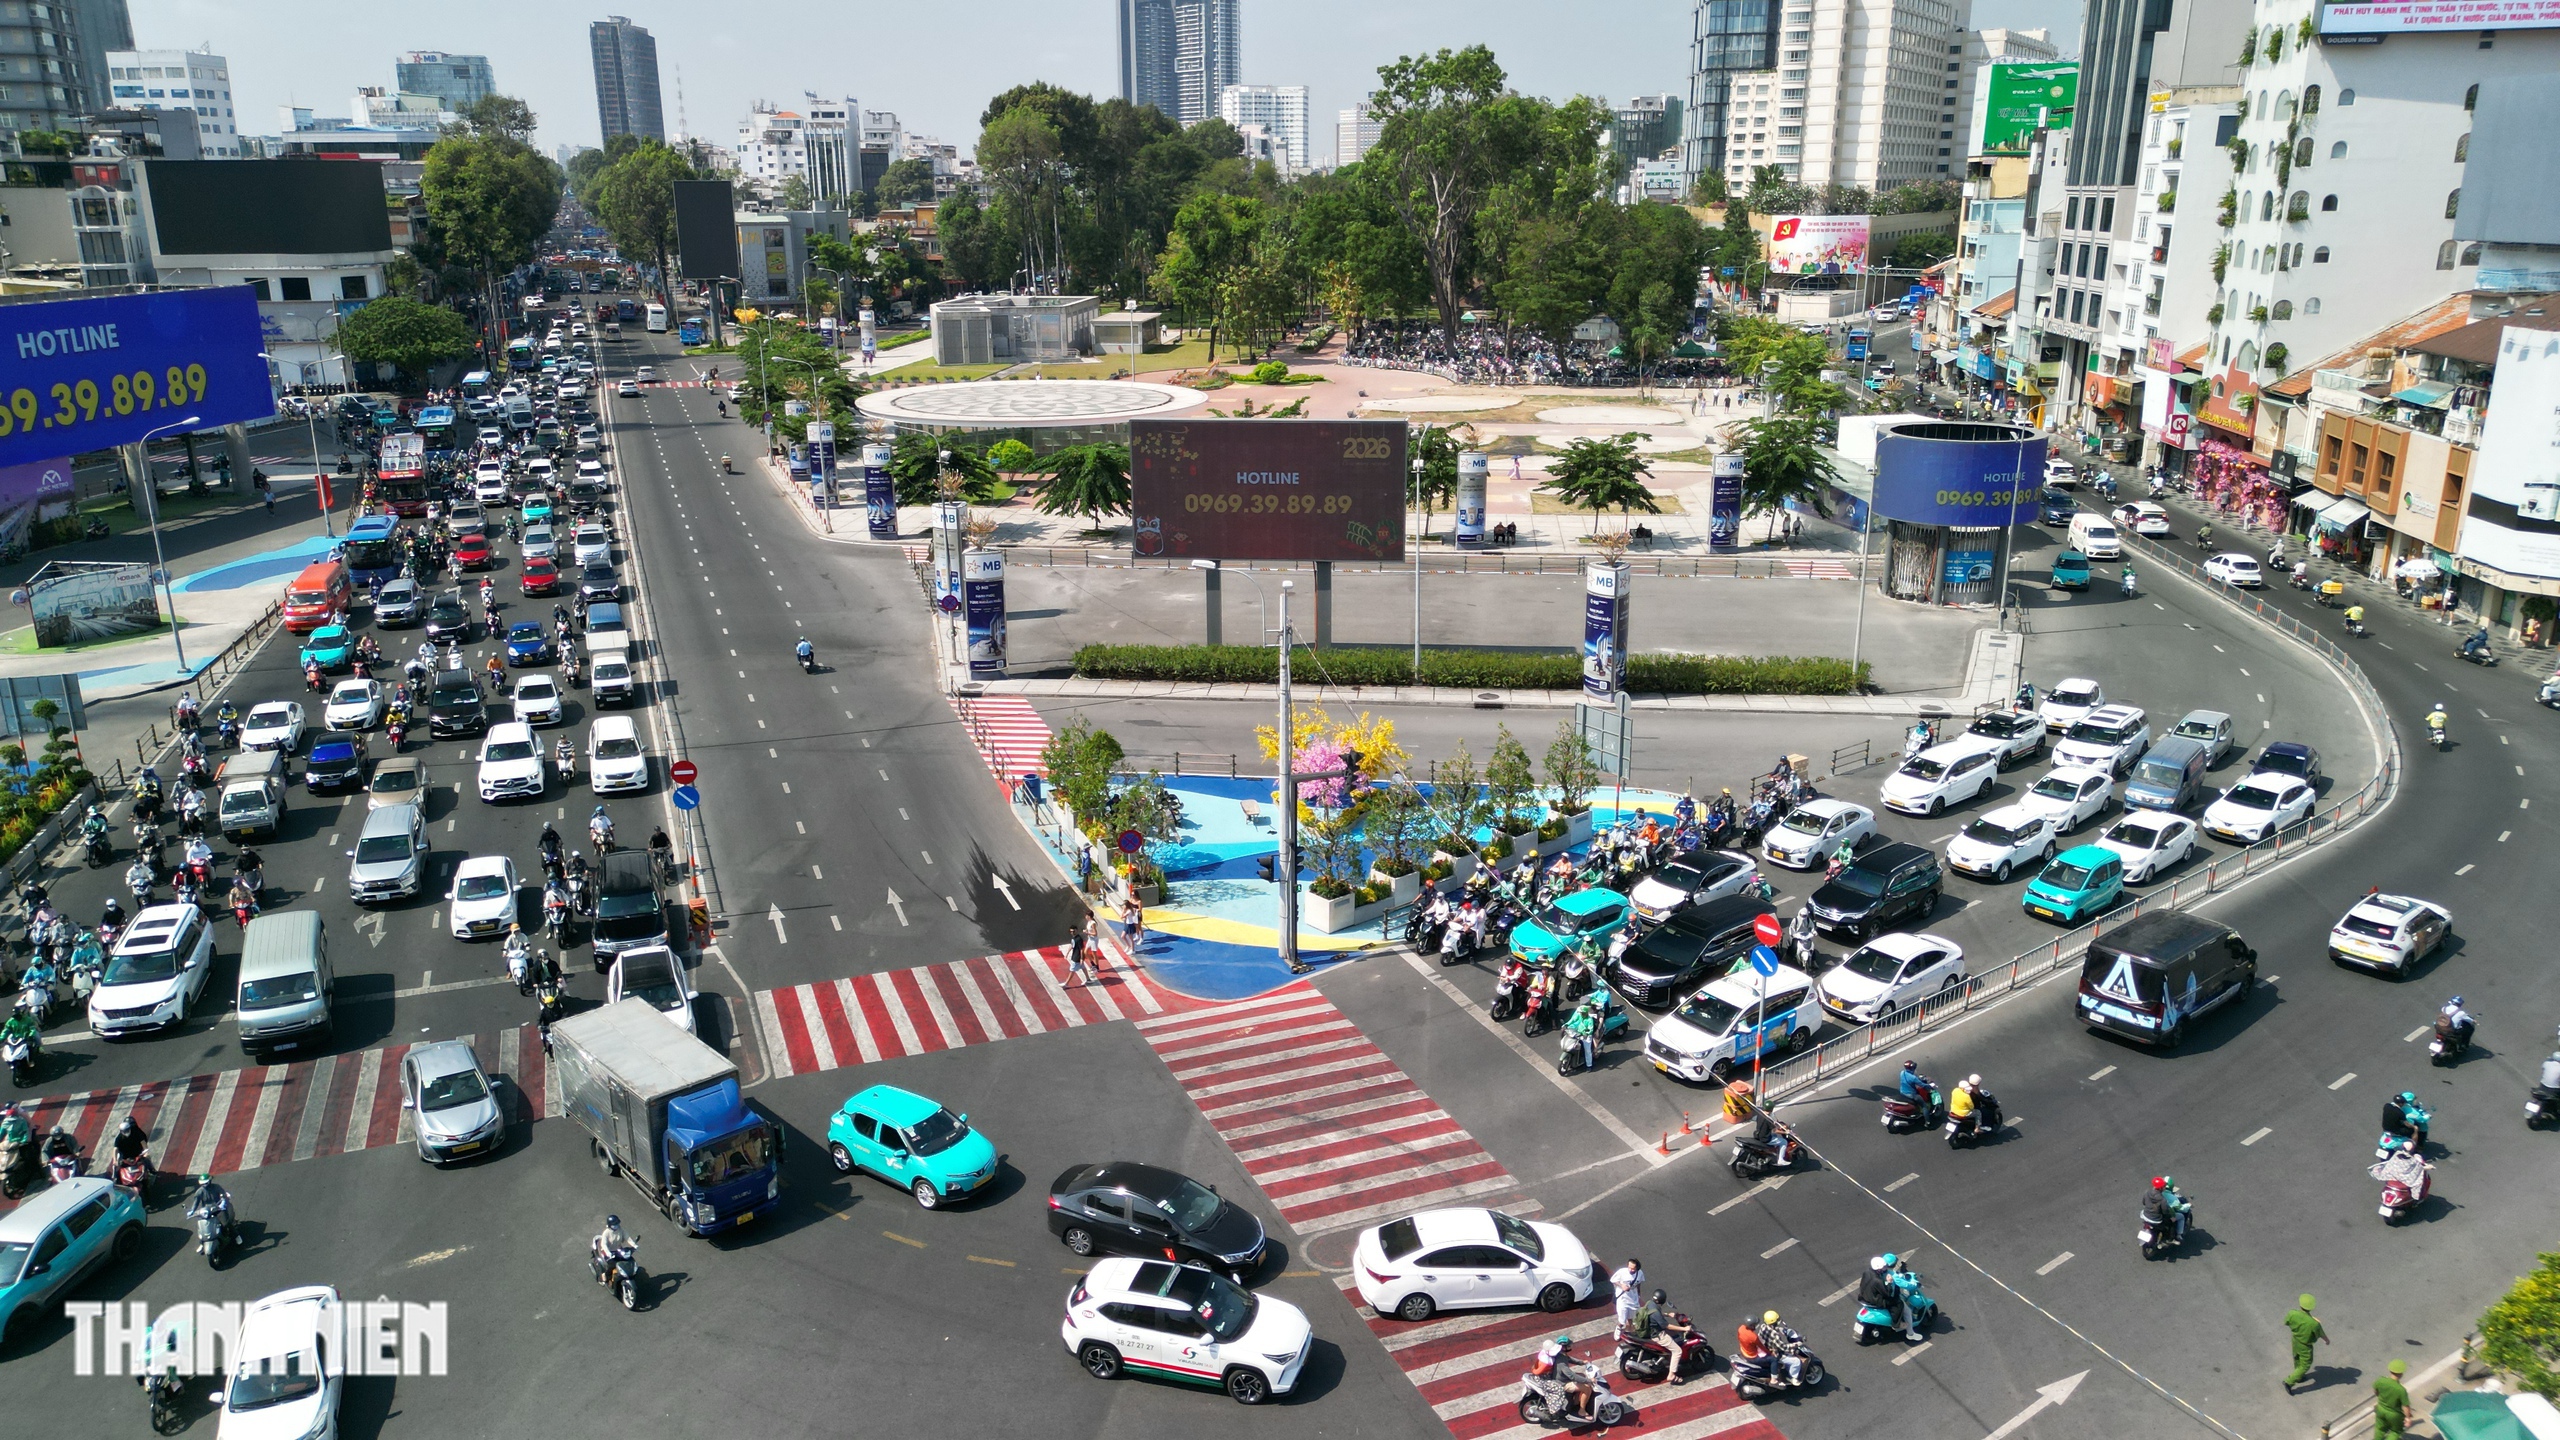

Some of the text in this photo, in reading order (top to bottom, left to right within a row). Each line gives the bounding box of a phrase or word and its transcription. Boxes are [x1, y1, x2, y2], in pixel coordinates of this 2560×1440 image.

[2333, 7, 2353, 15] PHÁT
[2373, 7, 2398, 16] MẠNH
[2414, 6, 2432, 14] TINH
[2504, 2, 2514, 11] TỰ
[2534, 2, 2545, 10] TỰ
[16, 323, 120, 359] HOTLINE
[1343, 437, 1391, 459] 2026
[875, 452, 890, 461] MB
[1472, 460, 1486, 468] MB
[1729, 462, 1743, 470] MB
[1236, 471, 1300, 485] HOTLINE
[1184, 493, 1352, 514] 0969.39.89.89
[982, 560, 1002, 572] MB
[116, 573, 141, 582] HDBank
[1596, 576, 1614, 588] MB
[732, 1190, 752, 1200] ISUZU
